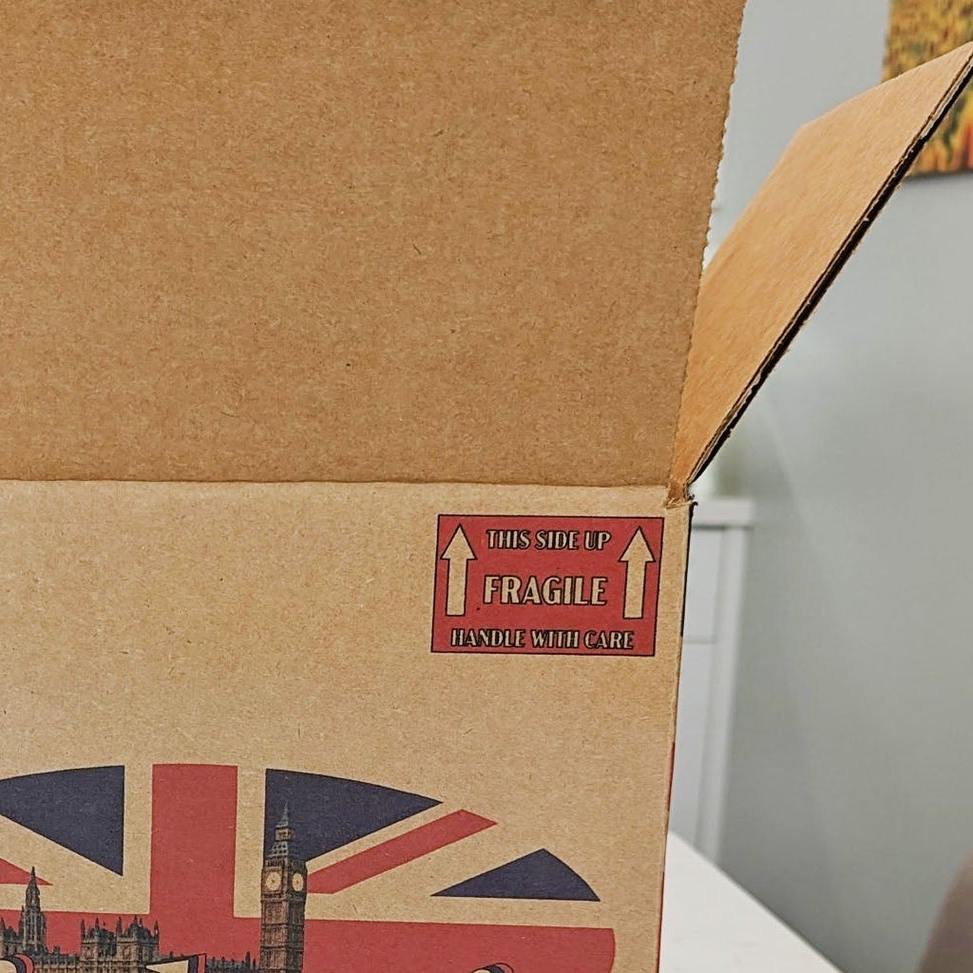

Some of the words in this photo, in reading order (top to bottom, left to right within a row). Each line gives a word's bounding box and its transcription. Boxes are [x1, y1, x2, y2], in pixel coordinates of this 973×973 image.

[486, 529, 531, 549] THIS
[534, 530, 579, 550] SIDE
[584, 531, 611, 550] UP
[482, 574, 608, 606] FRAGILE
[450, 628, 526, 648] HANDLE
[530, 629, 579, 649] WITH
[584, 630, 634, 650] CARE
